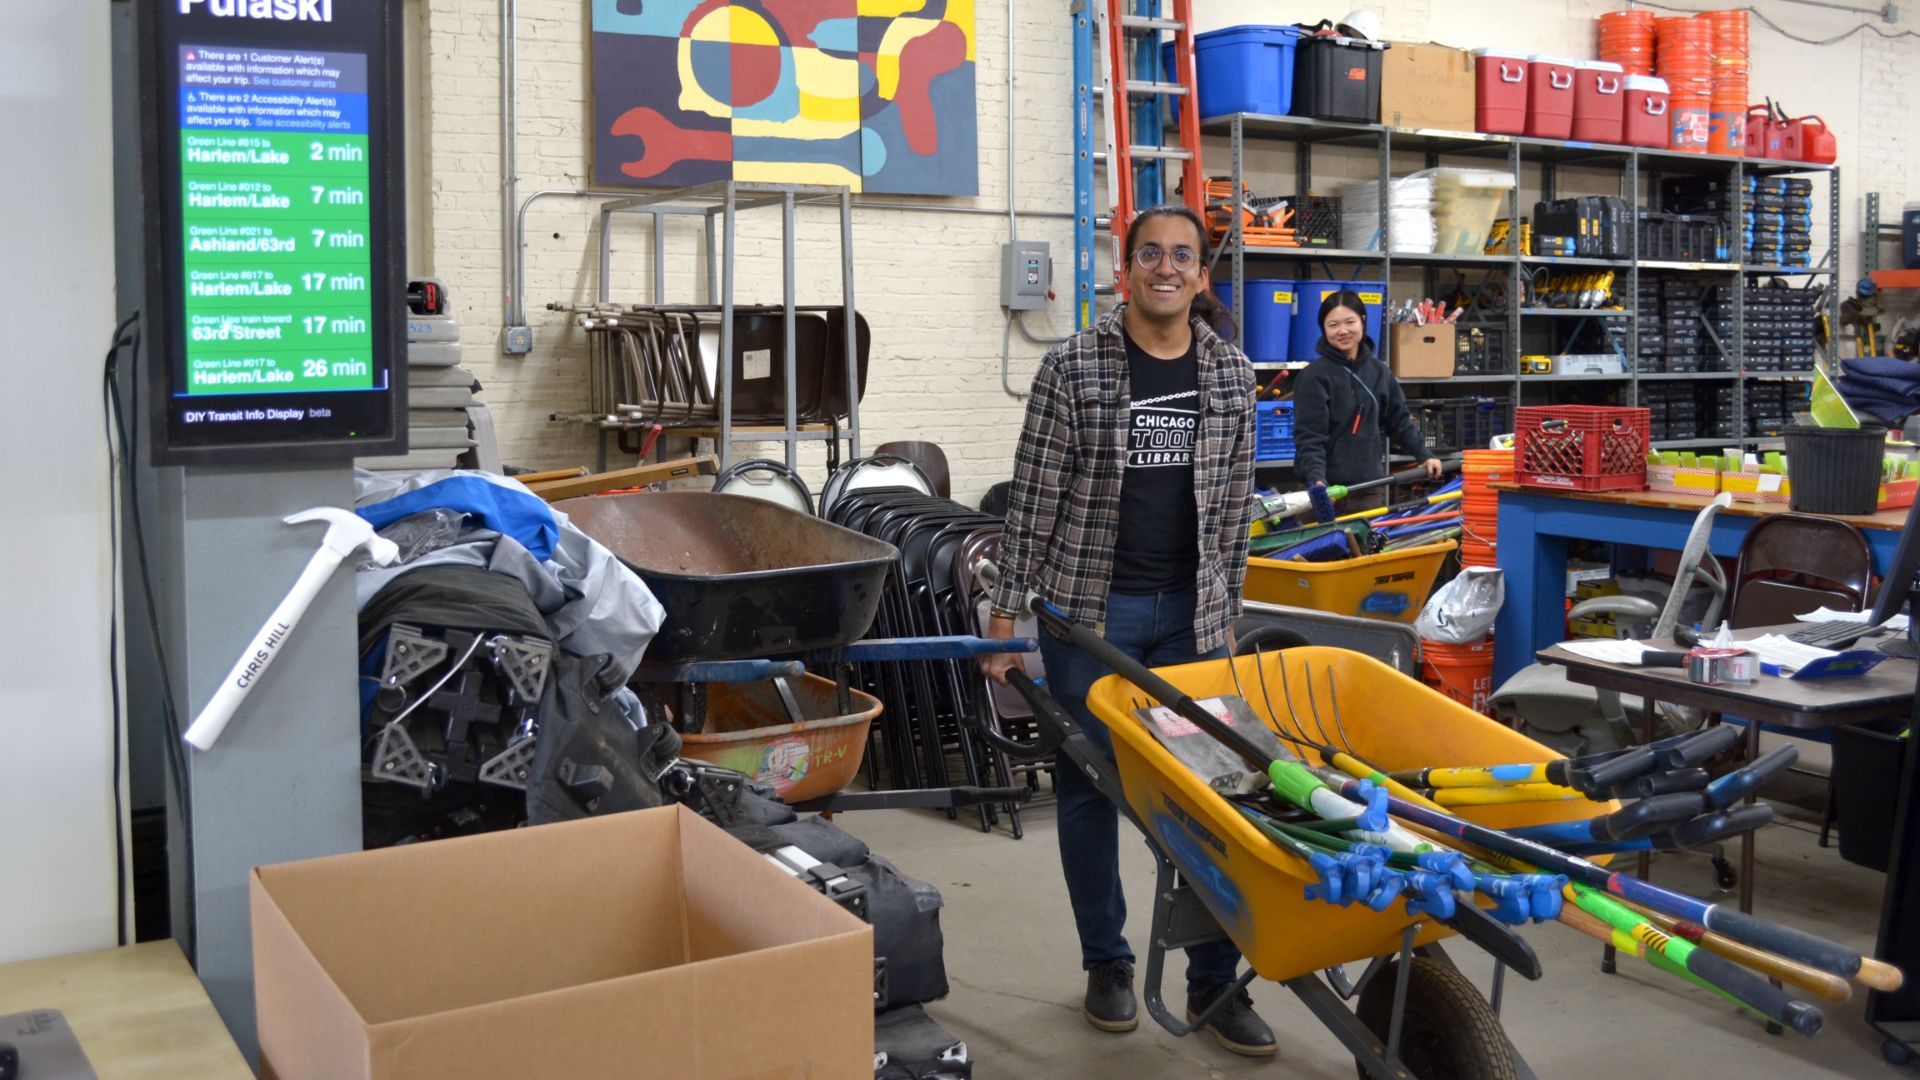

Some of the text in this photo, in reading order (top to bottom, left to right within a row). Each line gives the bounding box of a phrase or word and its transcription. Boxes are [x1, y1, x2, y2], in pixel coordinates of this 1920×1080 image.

[200, 51, 225, 61] There
[226, 53, 241, 62] are
[250, 53, 292, 64] Customer
[294, 55, 325, 66] Alert(s)
[186, 63, 341, 79] available with information which may
[186, 73, 211, 83] affect
[213, 75, 233, 86] your
[253, 76, 271, 86] See
[272, 78, 311, 87] customer
[313, 79, 336, 88] alerts
[200, 92, 336, 107] There are 2 Accessibility Alert(s)
[187, 104, 341, 120] available with information which may
[187, 115, 212, 126] affect
[214, 117, 234, 127] your
[256, 118, 274, 128] See
[275, 119, 325, 130] accessibility
[328, 120, 351, 130] alerts
[187, 136, 216, 146] Green
[217, 137, 237, 147] Line
[261, 139, 271, 148] to
[188, 147, 290, 164] Harlem/Lake
[310, 141, 363, 162] 2 min
[188, 181, 216, 191] Green
[218, 182, 238, 192] Line
[262, 183, 272, 192] to
[189, 192, 290, 209] Harlem/Lake
[311, 185, 363, 205] 7 min
[190, 226, 218, 236] Green
[219, 226, 238, 236] Line
[263, 227, 273, 236] to
[311, 229, 364, 248] 7 min
[190, 237, 296, 252] Ashland/63rd
[191, 271, 219, 281] Green
[220, 271, 239, 280] Line
[264, 271, 274, 280] to
[302, 272, 365, 291] 17 min
[191, 281, 293, 297] Harlem/Lake
[192, 314, 220, 324] Green
[241, 314, 261, 324] train
[262, 313, 292, 324] toward
[303, 316, 366, 334] 17 min
[192, 324, 282, 341] 63rd Street
[193, 359, 221, 369] Green
[222, 359, 241, 368] Line
[266, 358, 276, 368] to
[303, 359, 367, 378] 26 min
[193, 369, 295, 385] Harlem/Lake
[185, 408, 332, 423] DIY Transit Info Display beta
[1136, 415, 1195, 428] CHICAGO
[1132, 429, 1196, 448] TOOL
[1137, 453, 1194, 464] LIBRAR
[236, 622, 290, 689] CHRIS HILL
